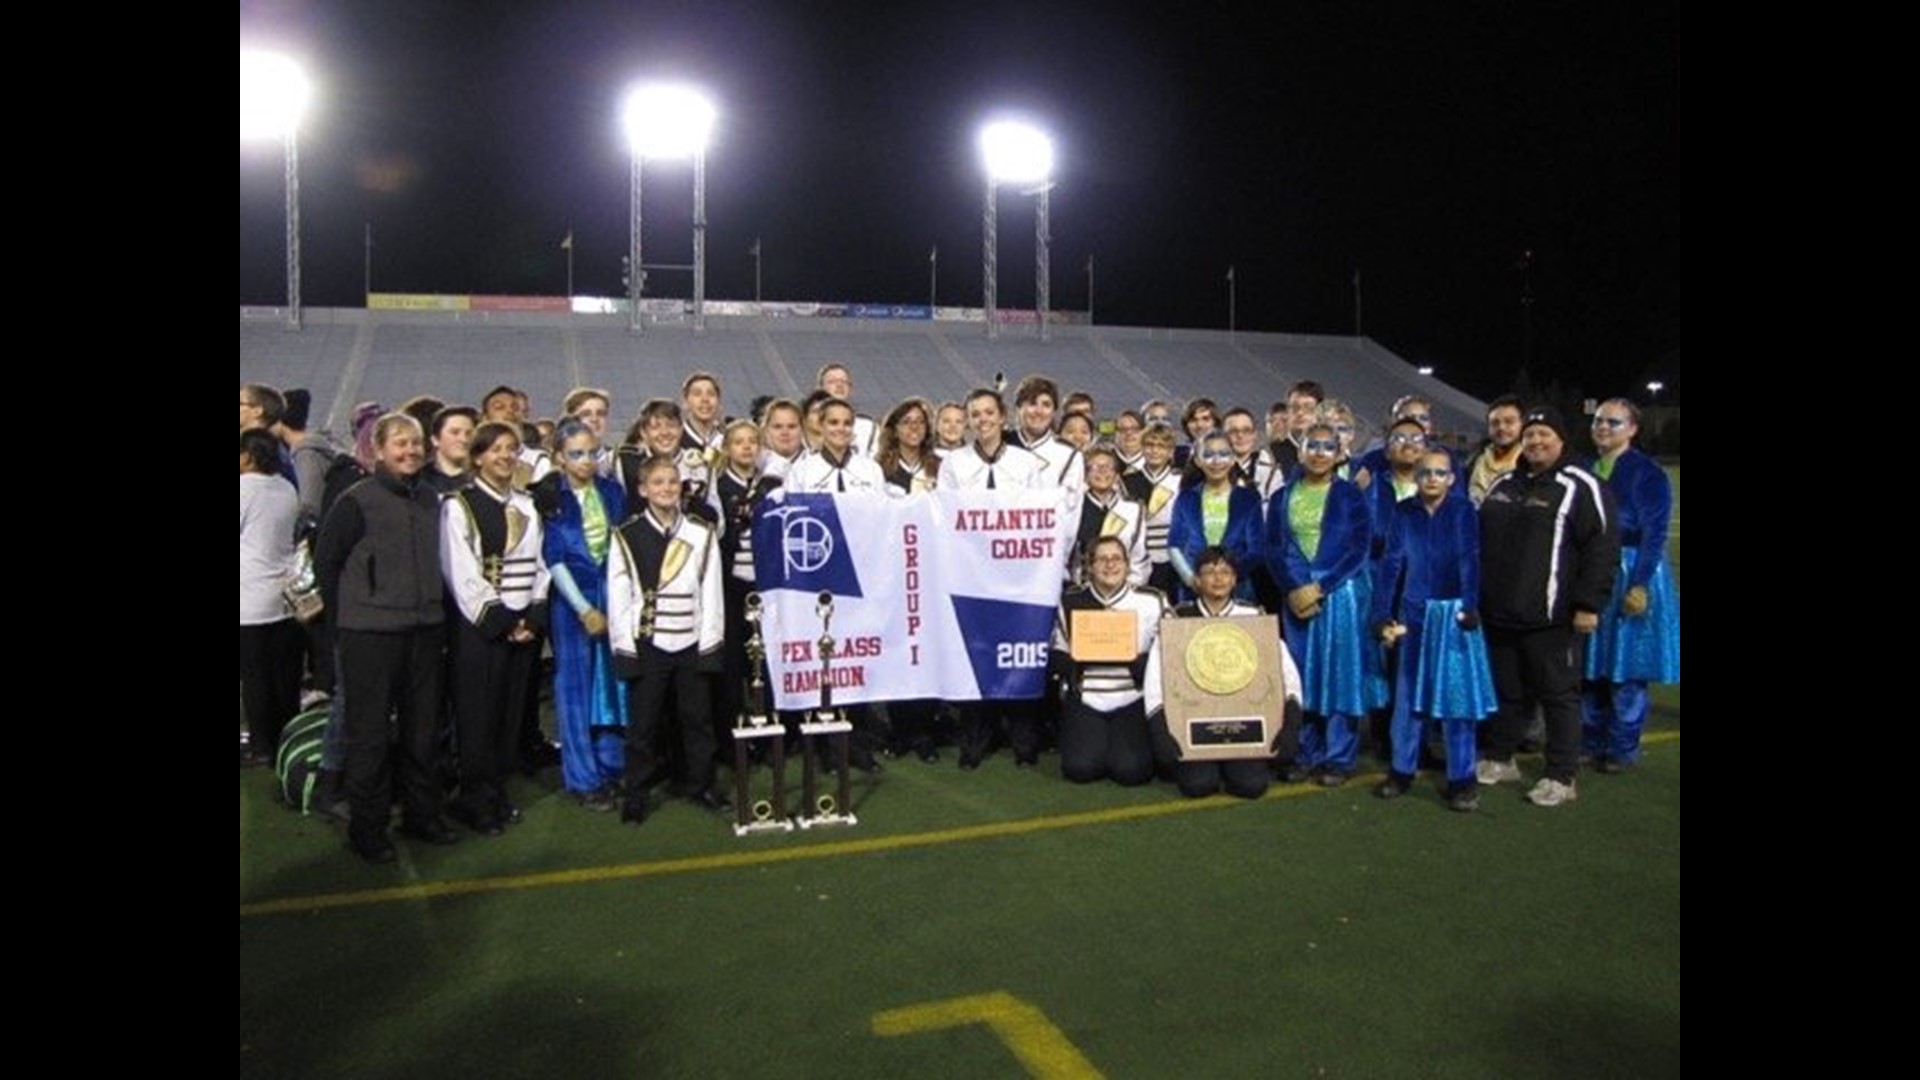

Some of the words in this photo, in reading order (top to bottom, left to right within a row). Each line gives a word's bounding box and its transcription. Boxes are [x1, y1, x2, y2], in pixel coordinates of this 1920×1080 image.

[955, 508, 1056, 531] ATLANTIC
[991, 537, 1056, 559] COAST
[902, 523, 921, 637] GROUP
[819, 637, 881, 661] LASS
[910, 645, 919, 666] I
[997, 642, 1049, 669] 2015
